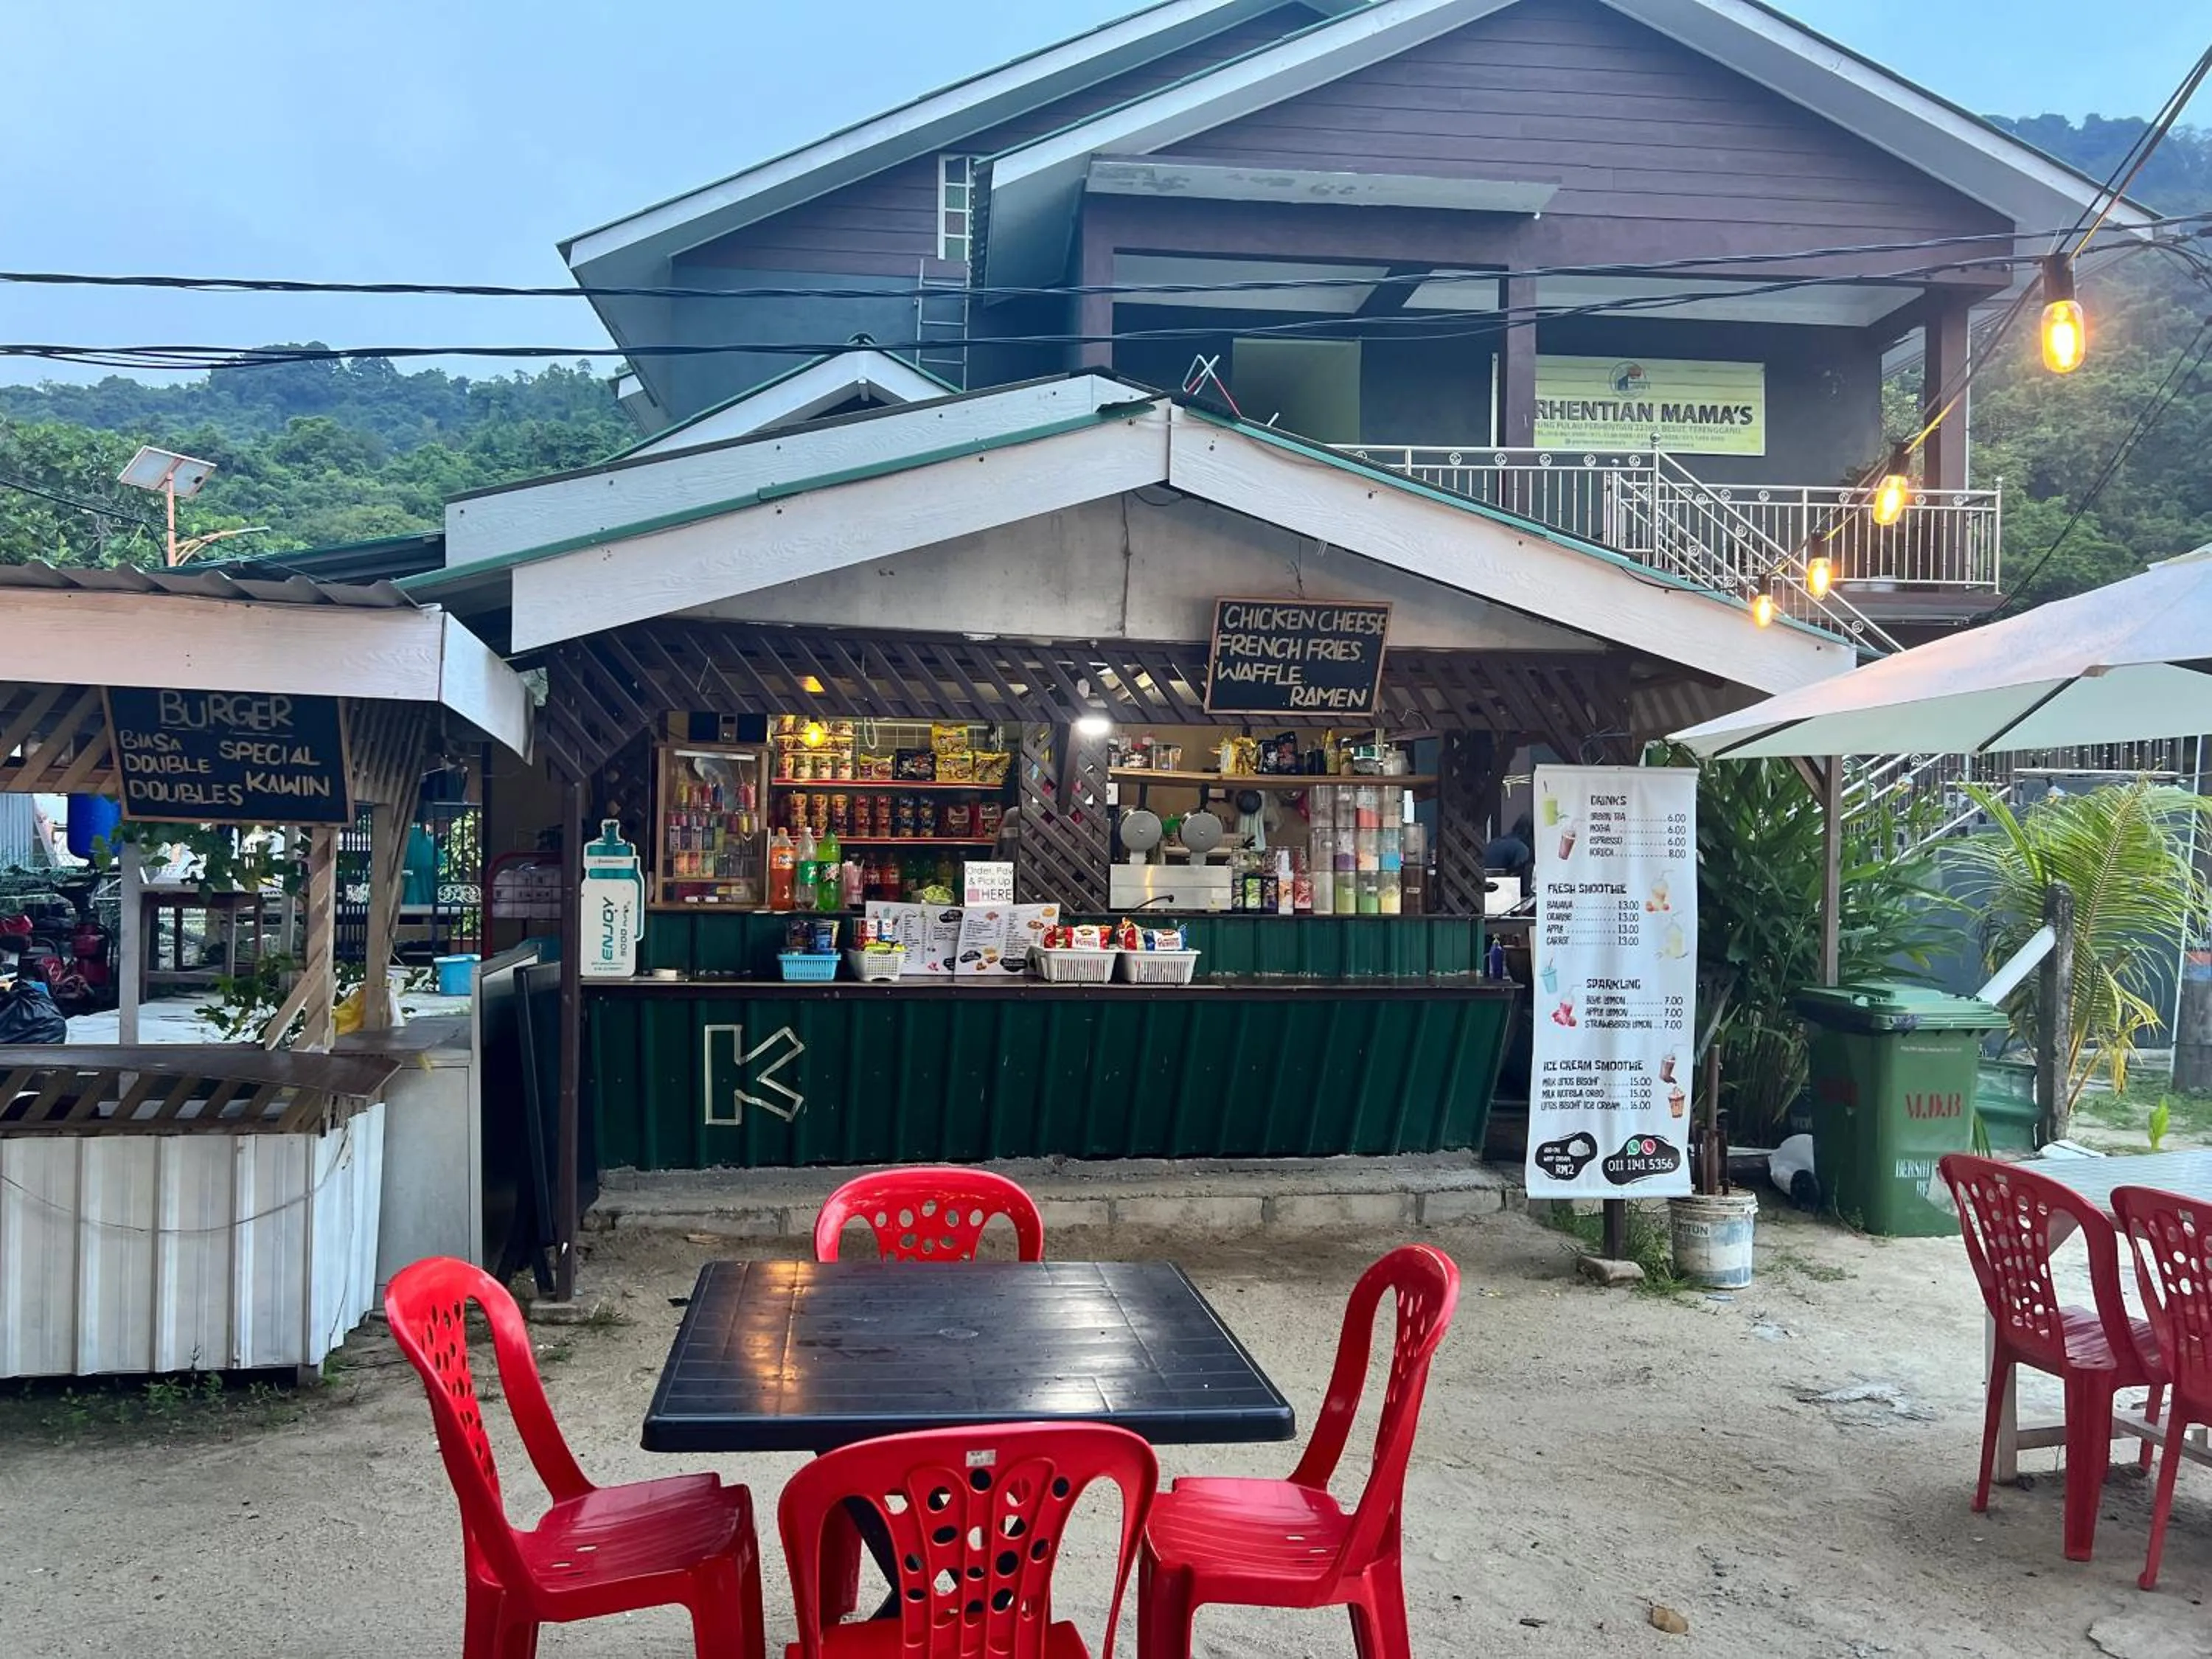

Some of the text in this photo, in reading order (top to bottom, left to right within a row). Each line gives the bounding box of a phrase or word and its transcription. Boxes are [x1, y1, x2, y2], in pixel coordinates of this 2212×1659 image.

[1534, 399, 1753, 425] RHENTIAN MAMA'S
[1225, 605, 1387, 635] CHICKEN CHEESE
[1216, 634, 1302, 660] FRENCH
[1290, 686, 1367, 708] RAMEN
[159, 690, 294, 731] BURGER
[220, 741, 321, 765] SPECIAL
[124, 754, 330, 796] DOUBLE KAWIN
[129, 779, 243, 807] DOUBLES
[1590, 796, 1627, 806] DRINKS
[1668, 814, 1686, 823] 6.00
[1667, 826, 1686, 834] 6.00
[1667, 838, 1686, 846] 6.00
[1669, 849, 1686, 858] 8.00
[981, 888, 1012, 900] HERE
[1548, 884, 1627, 894] FRESH SMOOTHIE
[1547, 901, 1639, 910] BANANA 13.00
[1618, 913, 1639, 922] 13.00
[602, 897, 614, 961] ENJOY
[1618, 925, 1639, 933] 13.00
[1618, 937, 1638, 945] 13.00
[1587, 979, 1641, 990] SPARKLING
[1664, 996, 1683, 1005] 7.00
[1664, 1009, 1683, 1017] 7.00
[1664, 1020, 1682, 1029] 7.00
[1543, 1060, 1644, 1071] ICE CREAM SMOOTHIE
[705, 1024, 805, 1125] K
[1630, 1077, 1652, 1086] 15.00
[1630, 1089, 1652, 1098] 15.00
[1555, 1164, 1574, 1175] RM2
[1608, 1161, 1624, 1172] 011
[1649, 1158, 1674, 1169] 5356
